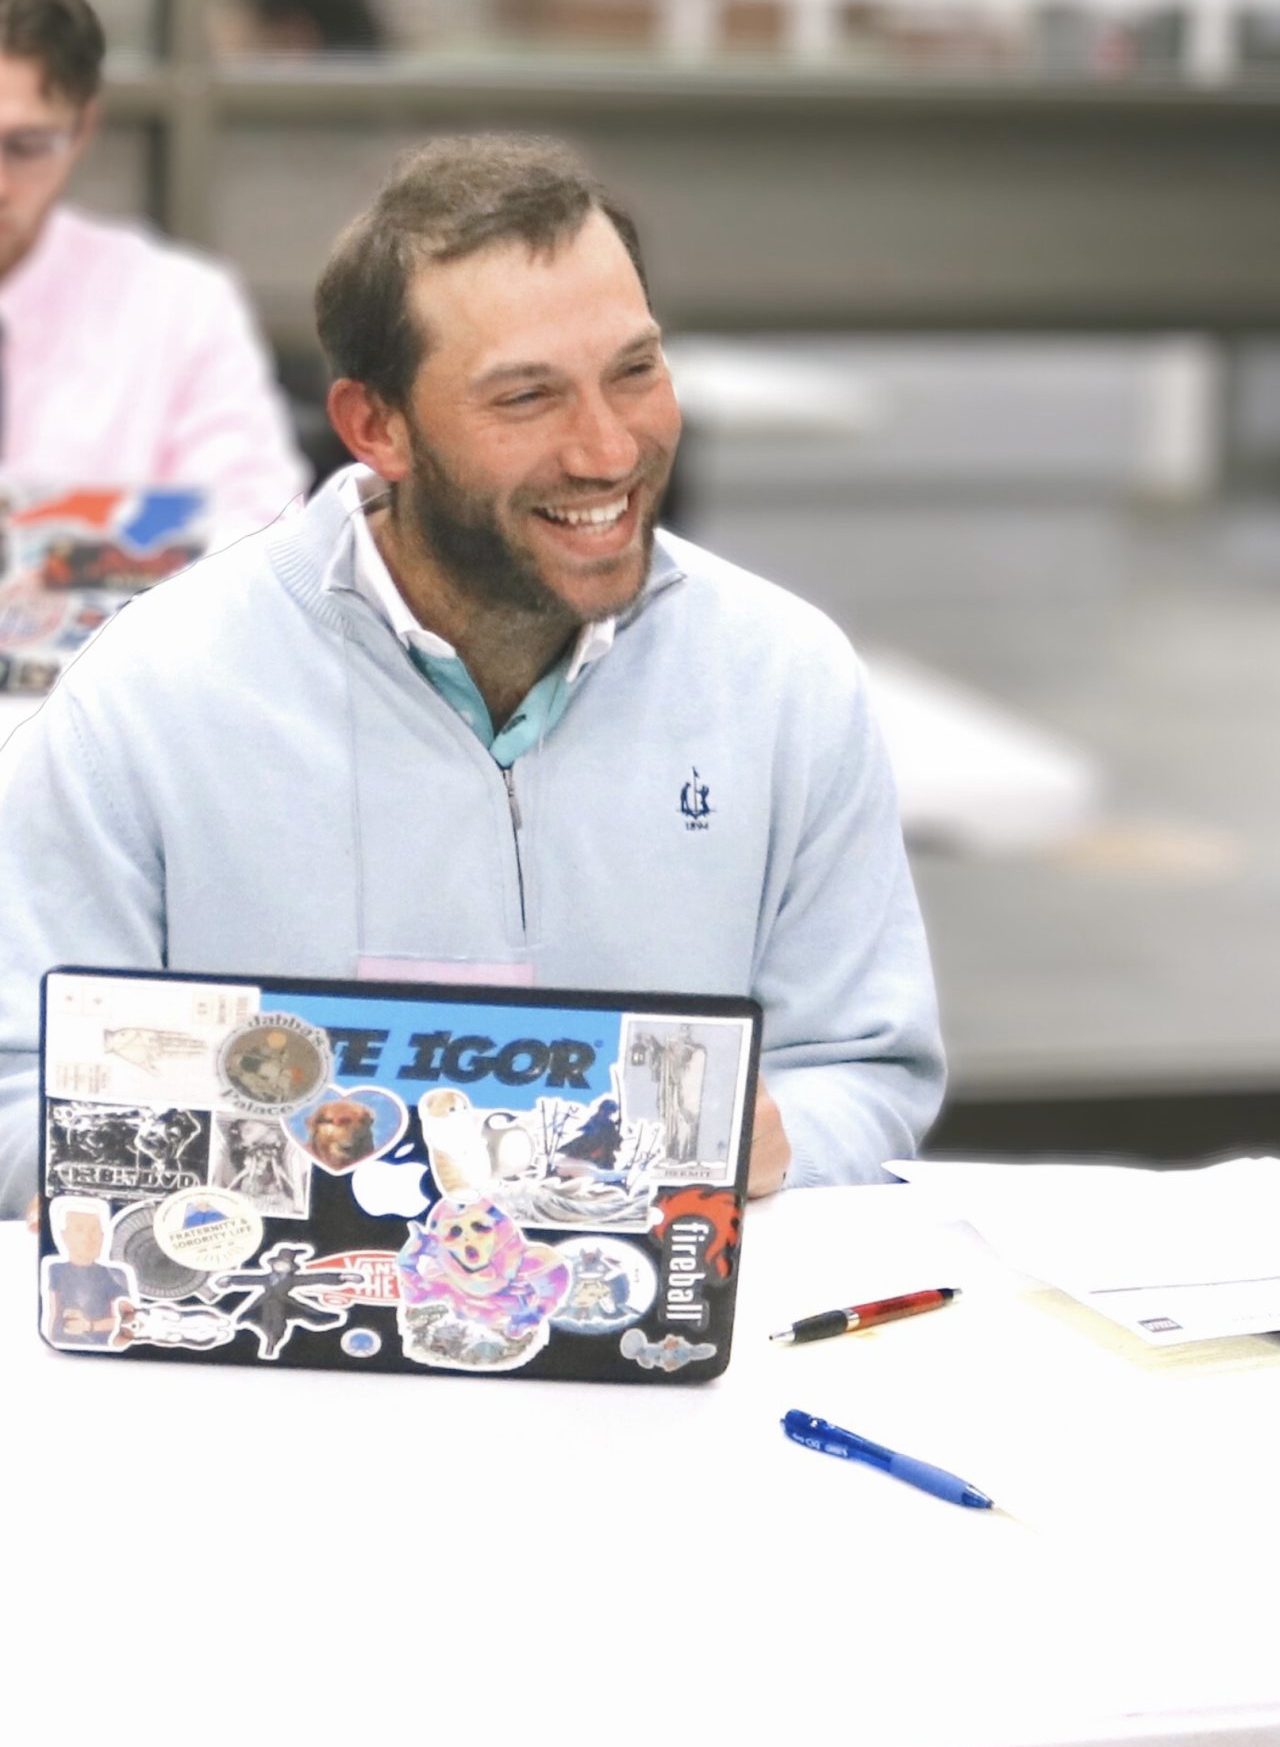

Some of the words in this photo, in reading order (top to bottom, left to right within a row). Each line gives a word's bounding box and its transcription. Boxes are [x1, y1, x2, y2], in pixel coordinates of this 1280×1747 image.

[396, 1030, 596, 1089] IGOR
[169, 1220, 236, 1240] FRATERNITY
[172, 1231, 226, 1250] SORORITY
[666, 1222, 709, 1320] fireball
